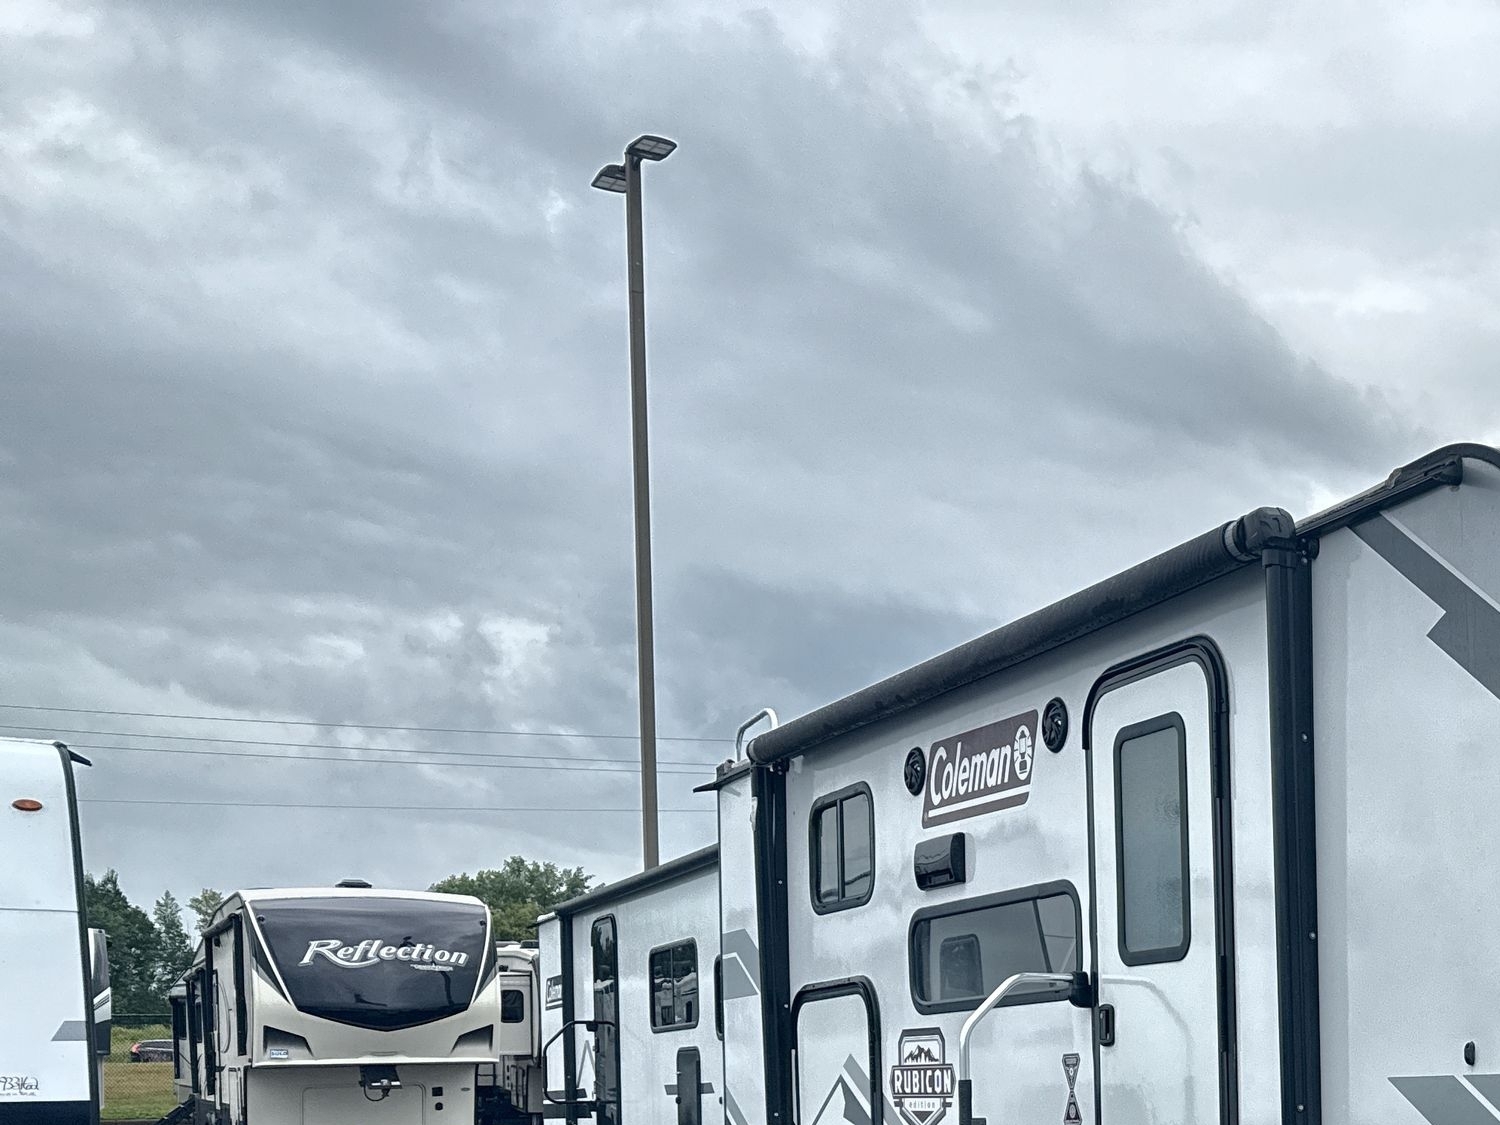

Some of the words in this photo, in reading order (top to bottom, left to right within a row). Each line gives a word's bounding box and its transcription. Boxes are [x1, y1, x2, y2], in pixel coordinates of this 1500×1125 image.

[930, 741, 1012, 806] Coleman
[297, 939, 470, 969] Reflection
[894, 1069, 952, 1094] RUBICON
[908, 1101, 936, 1109] edition
